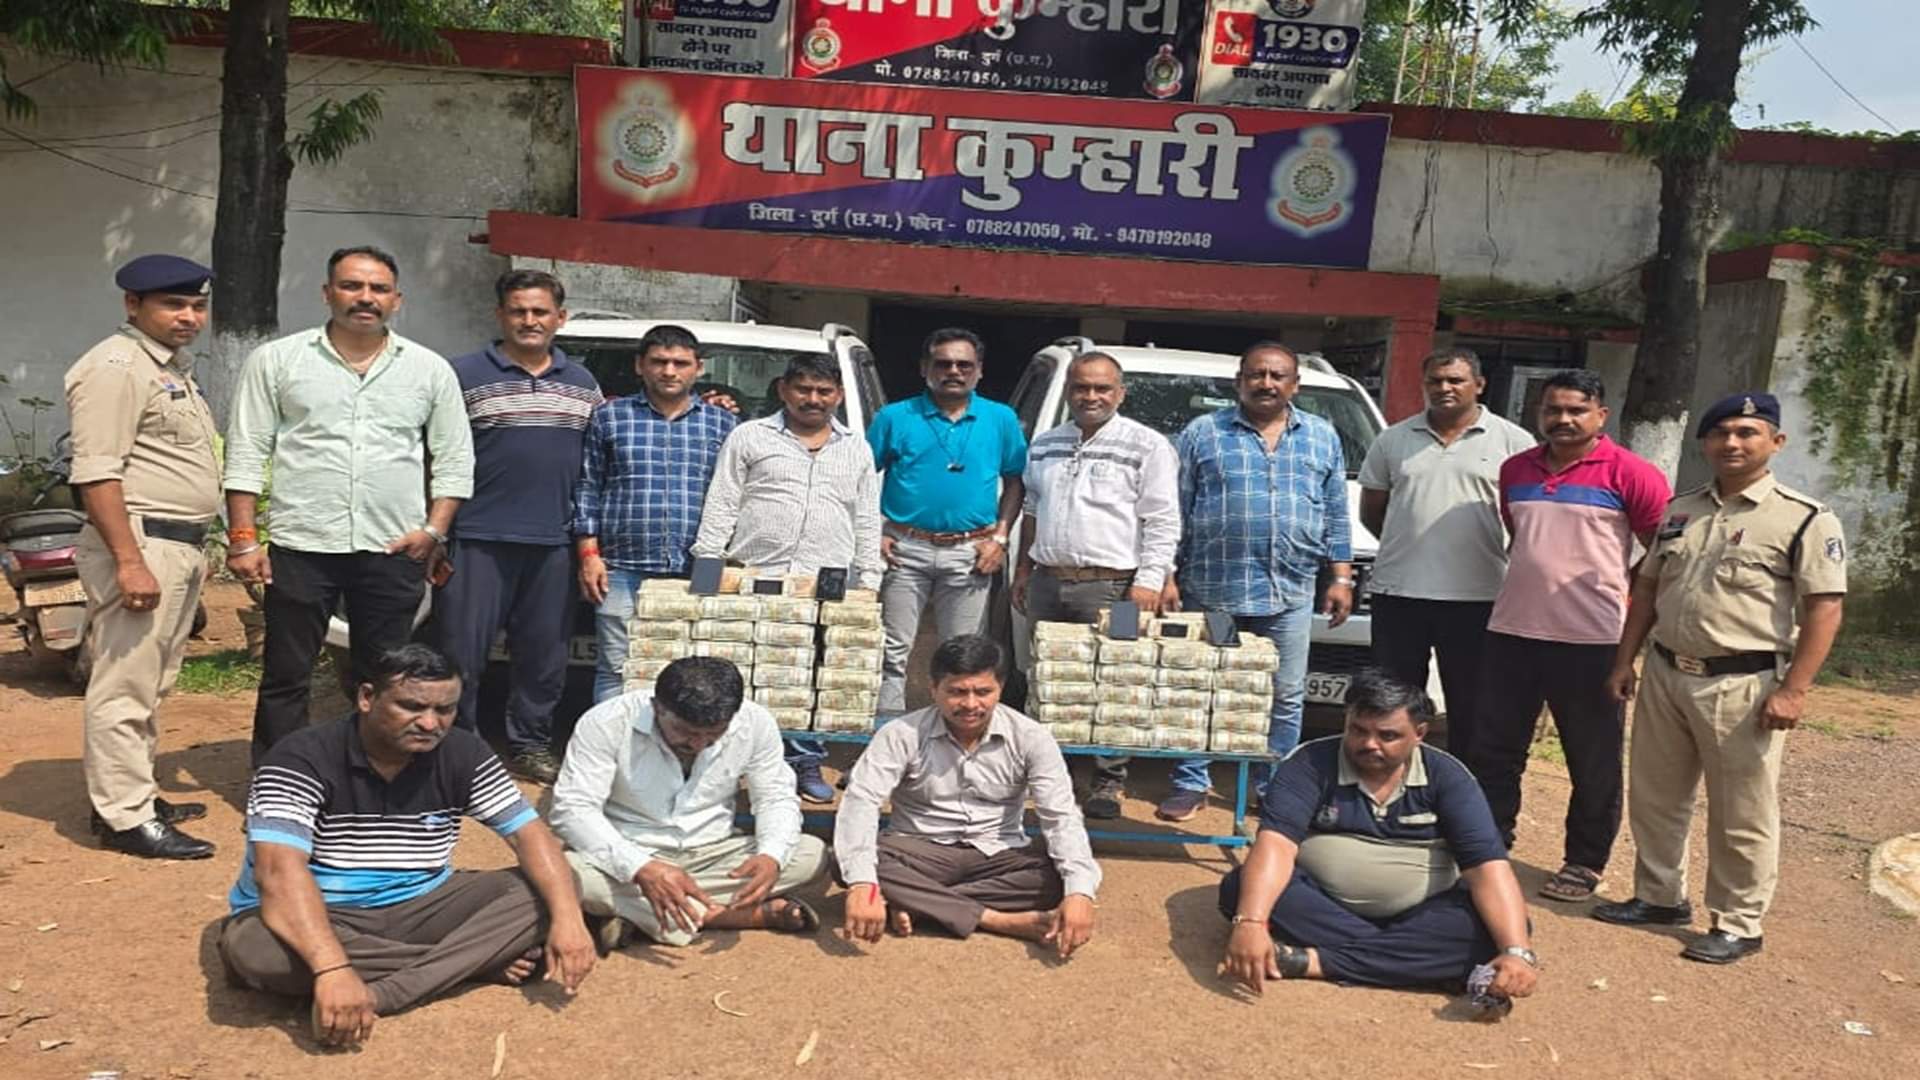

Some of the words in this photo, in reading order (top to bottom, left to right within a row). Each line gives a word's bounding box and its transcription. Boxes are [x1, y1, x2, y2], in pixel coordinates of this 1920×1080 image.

[681, 38, 709, 53] होने
[712, 43, 731, 55] पर
[1263, 23, 1348, 53] 1930
[1256, 84, 1282, 98] होने
[1285, 88, 1304, 100] पर
[721, 102, 934, 180] थाना
[947, 112, 1255, 211] कुम्हारी
[748, 202, 795, 222] जिला
[811, 206, 839, 229] दुर्ग
[844, 209, 902, 232] (छ.ग.)
[909, 213, 944, 231] फोन
[1072, 223, 1099, 241] मो.
[1307, 679, 1346, 699] 957
